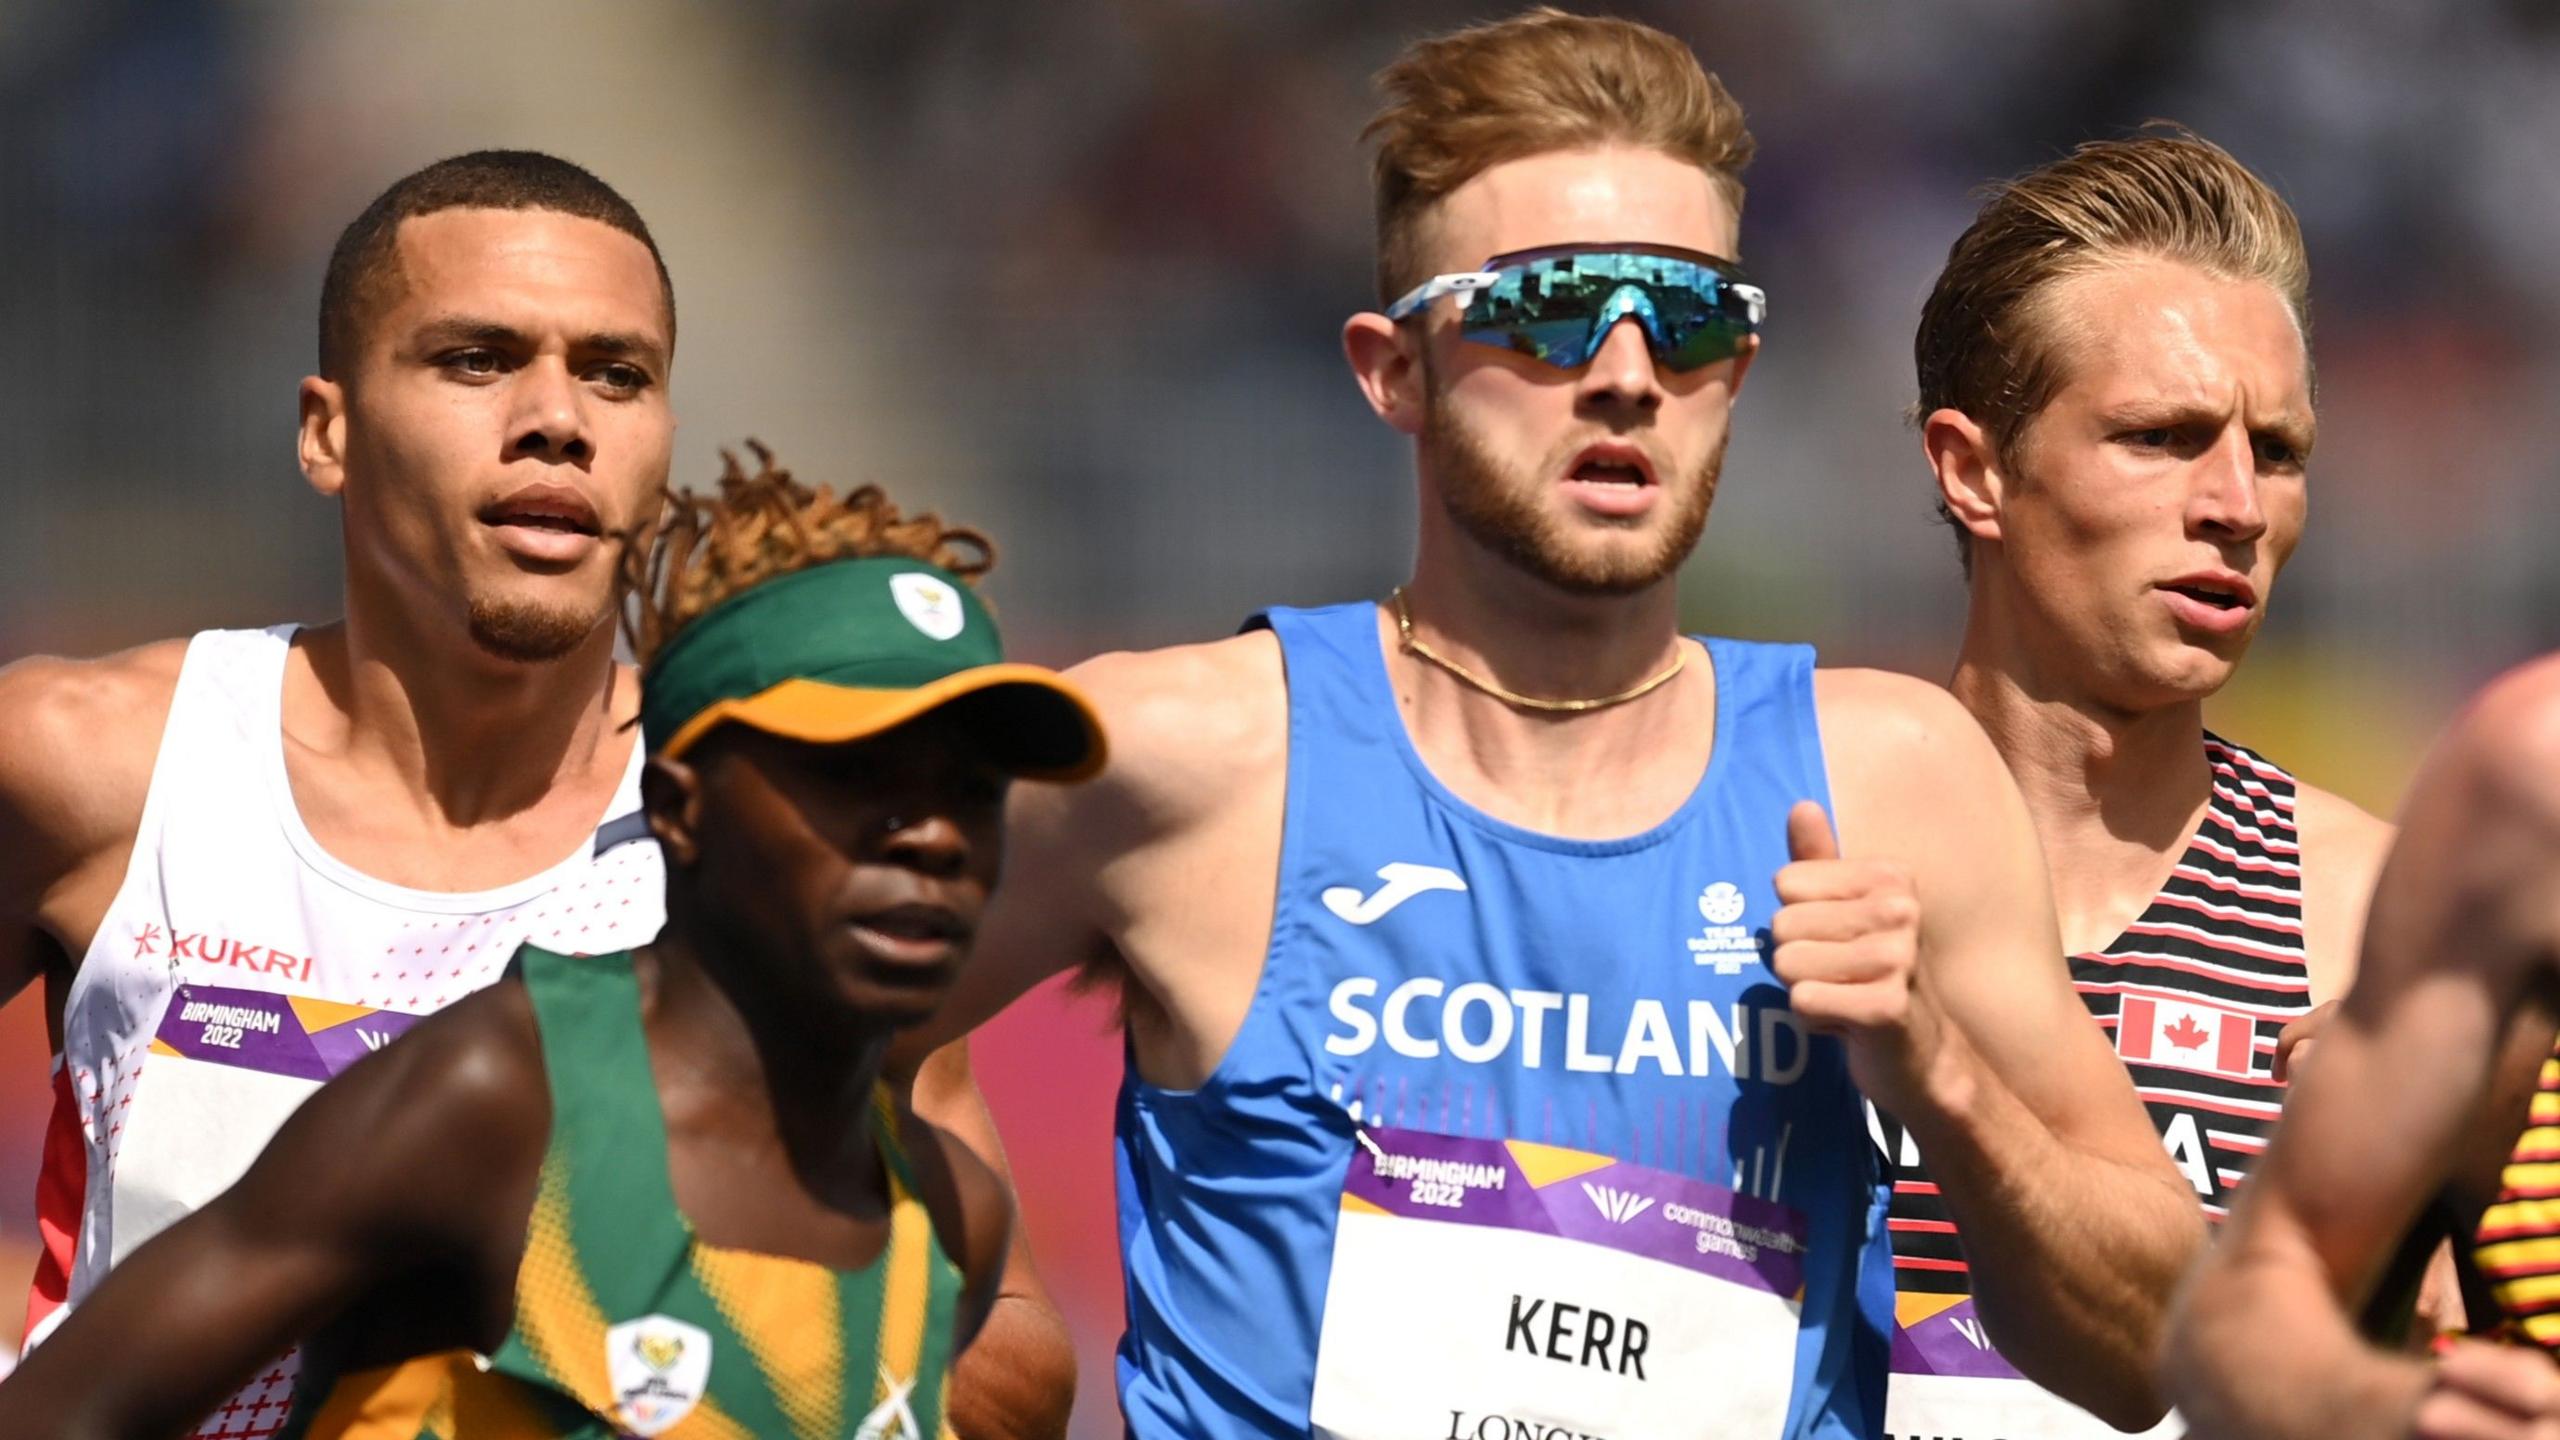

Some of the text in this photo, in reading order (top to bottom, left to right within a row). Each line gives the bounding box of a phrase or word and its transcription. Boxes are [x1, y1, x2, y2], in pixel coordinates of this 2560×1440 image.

[169, 930, 313, 982] KUKRI
[180, 1002, 281, 1034] BIRMINGHAM
[1325, 977, 1810, 1085] SCOTLAND
[200, 1025, 243, 1050] 2022
[1373, 1153, 1506, 1190] BIRMINGHAM
[1410, 1180, 1464, 1208] 2022
[1696, 1230, 1758, 1262] games
[1505, 1294, 1650, 1381] KERR
